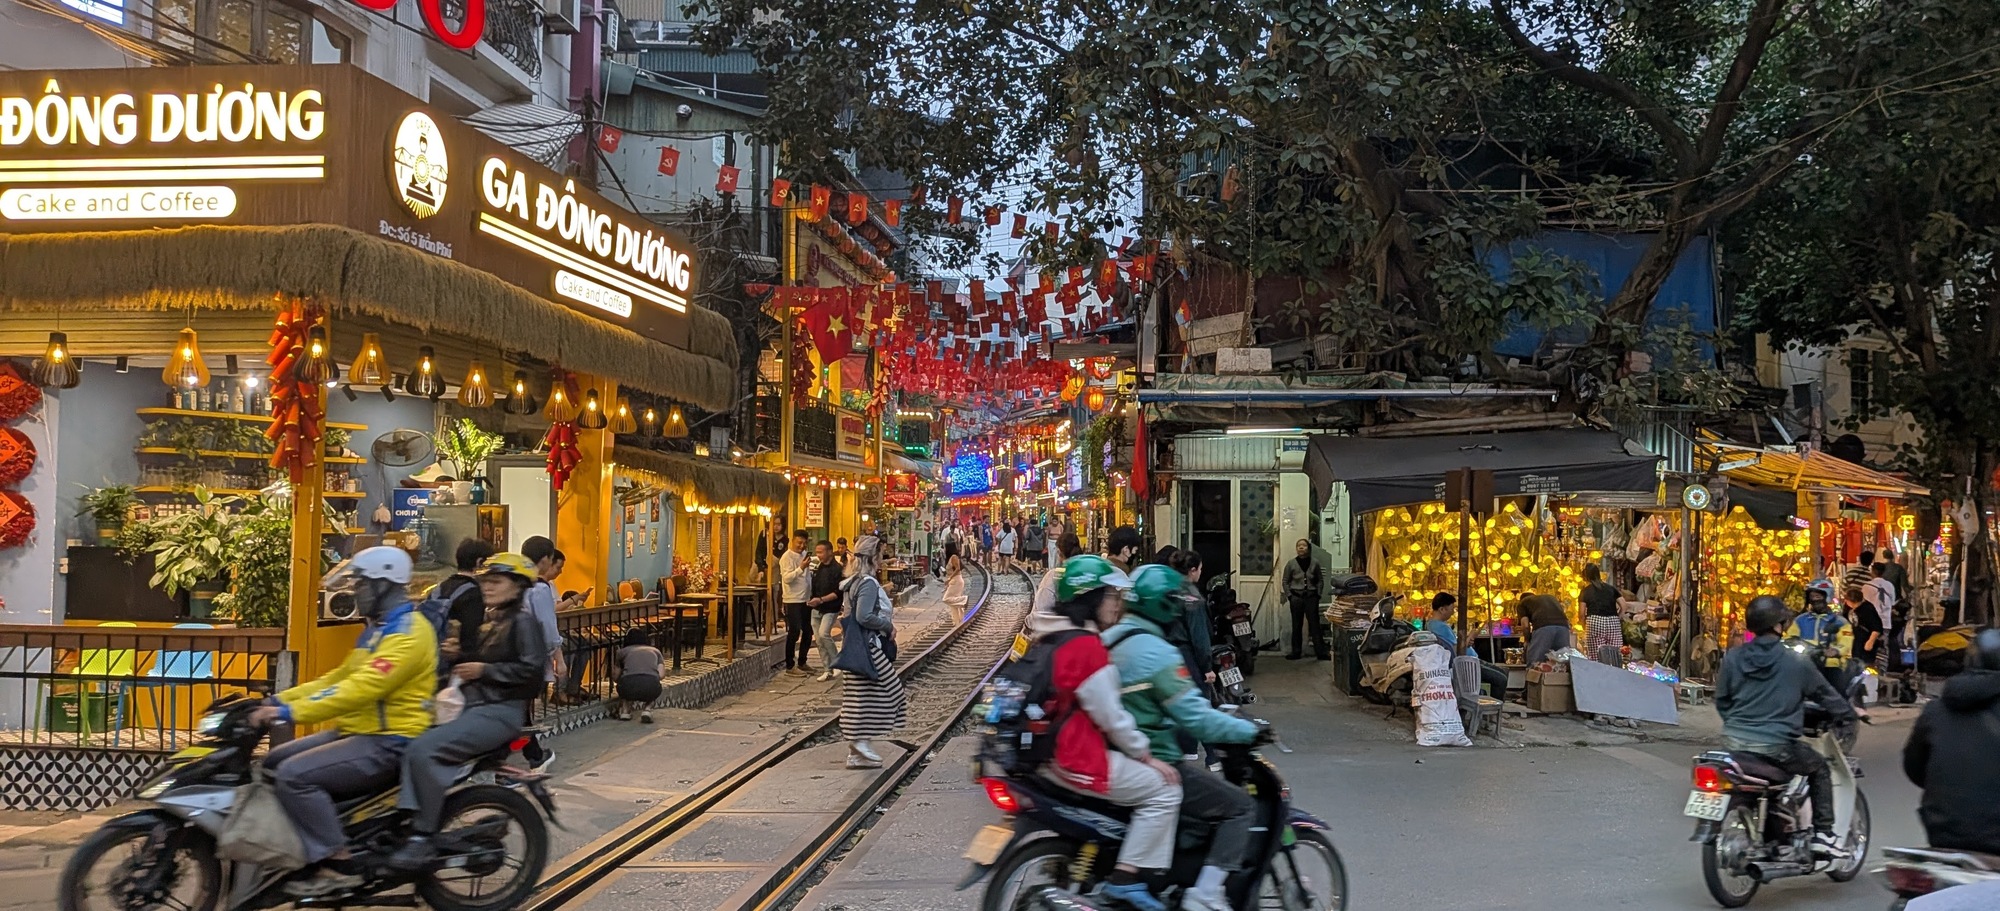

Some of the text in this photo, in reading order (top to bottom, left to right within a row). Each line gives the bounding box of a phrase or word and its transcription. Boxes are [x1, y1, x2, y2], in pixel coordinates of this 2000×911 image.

[0, 78, 325, 146] ĐÔNG DƯƠNG
[16, 192, 219, 213] Cake and Coffee
[410, 232, 418, 246] 5
[482, 157, 690, 291] GA ĐÔNG DƯƠNG
[561, 275, 627, 313] Cake and Coffee
